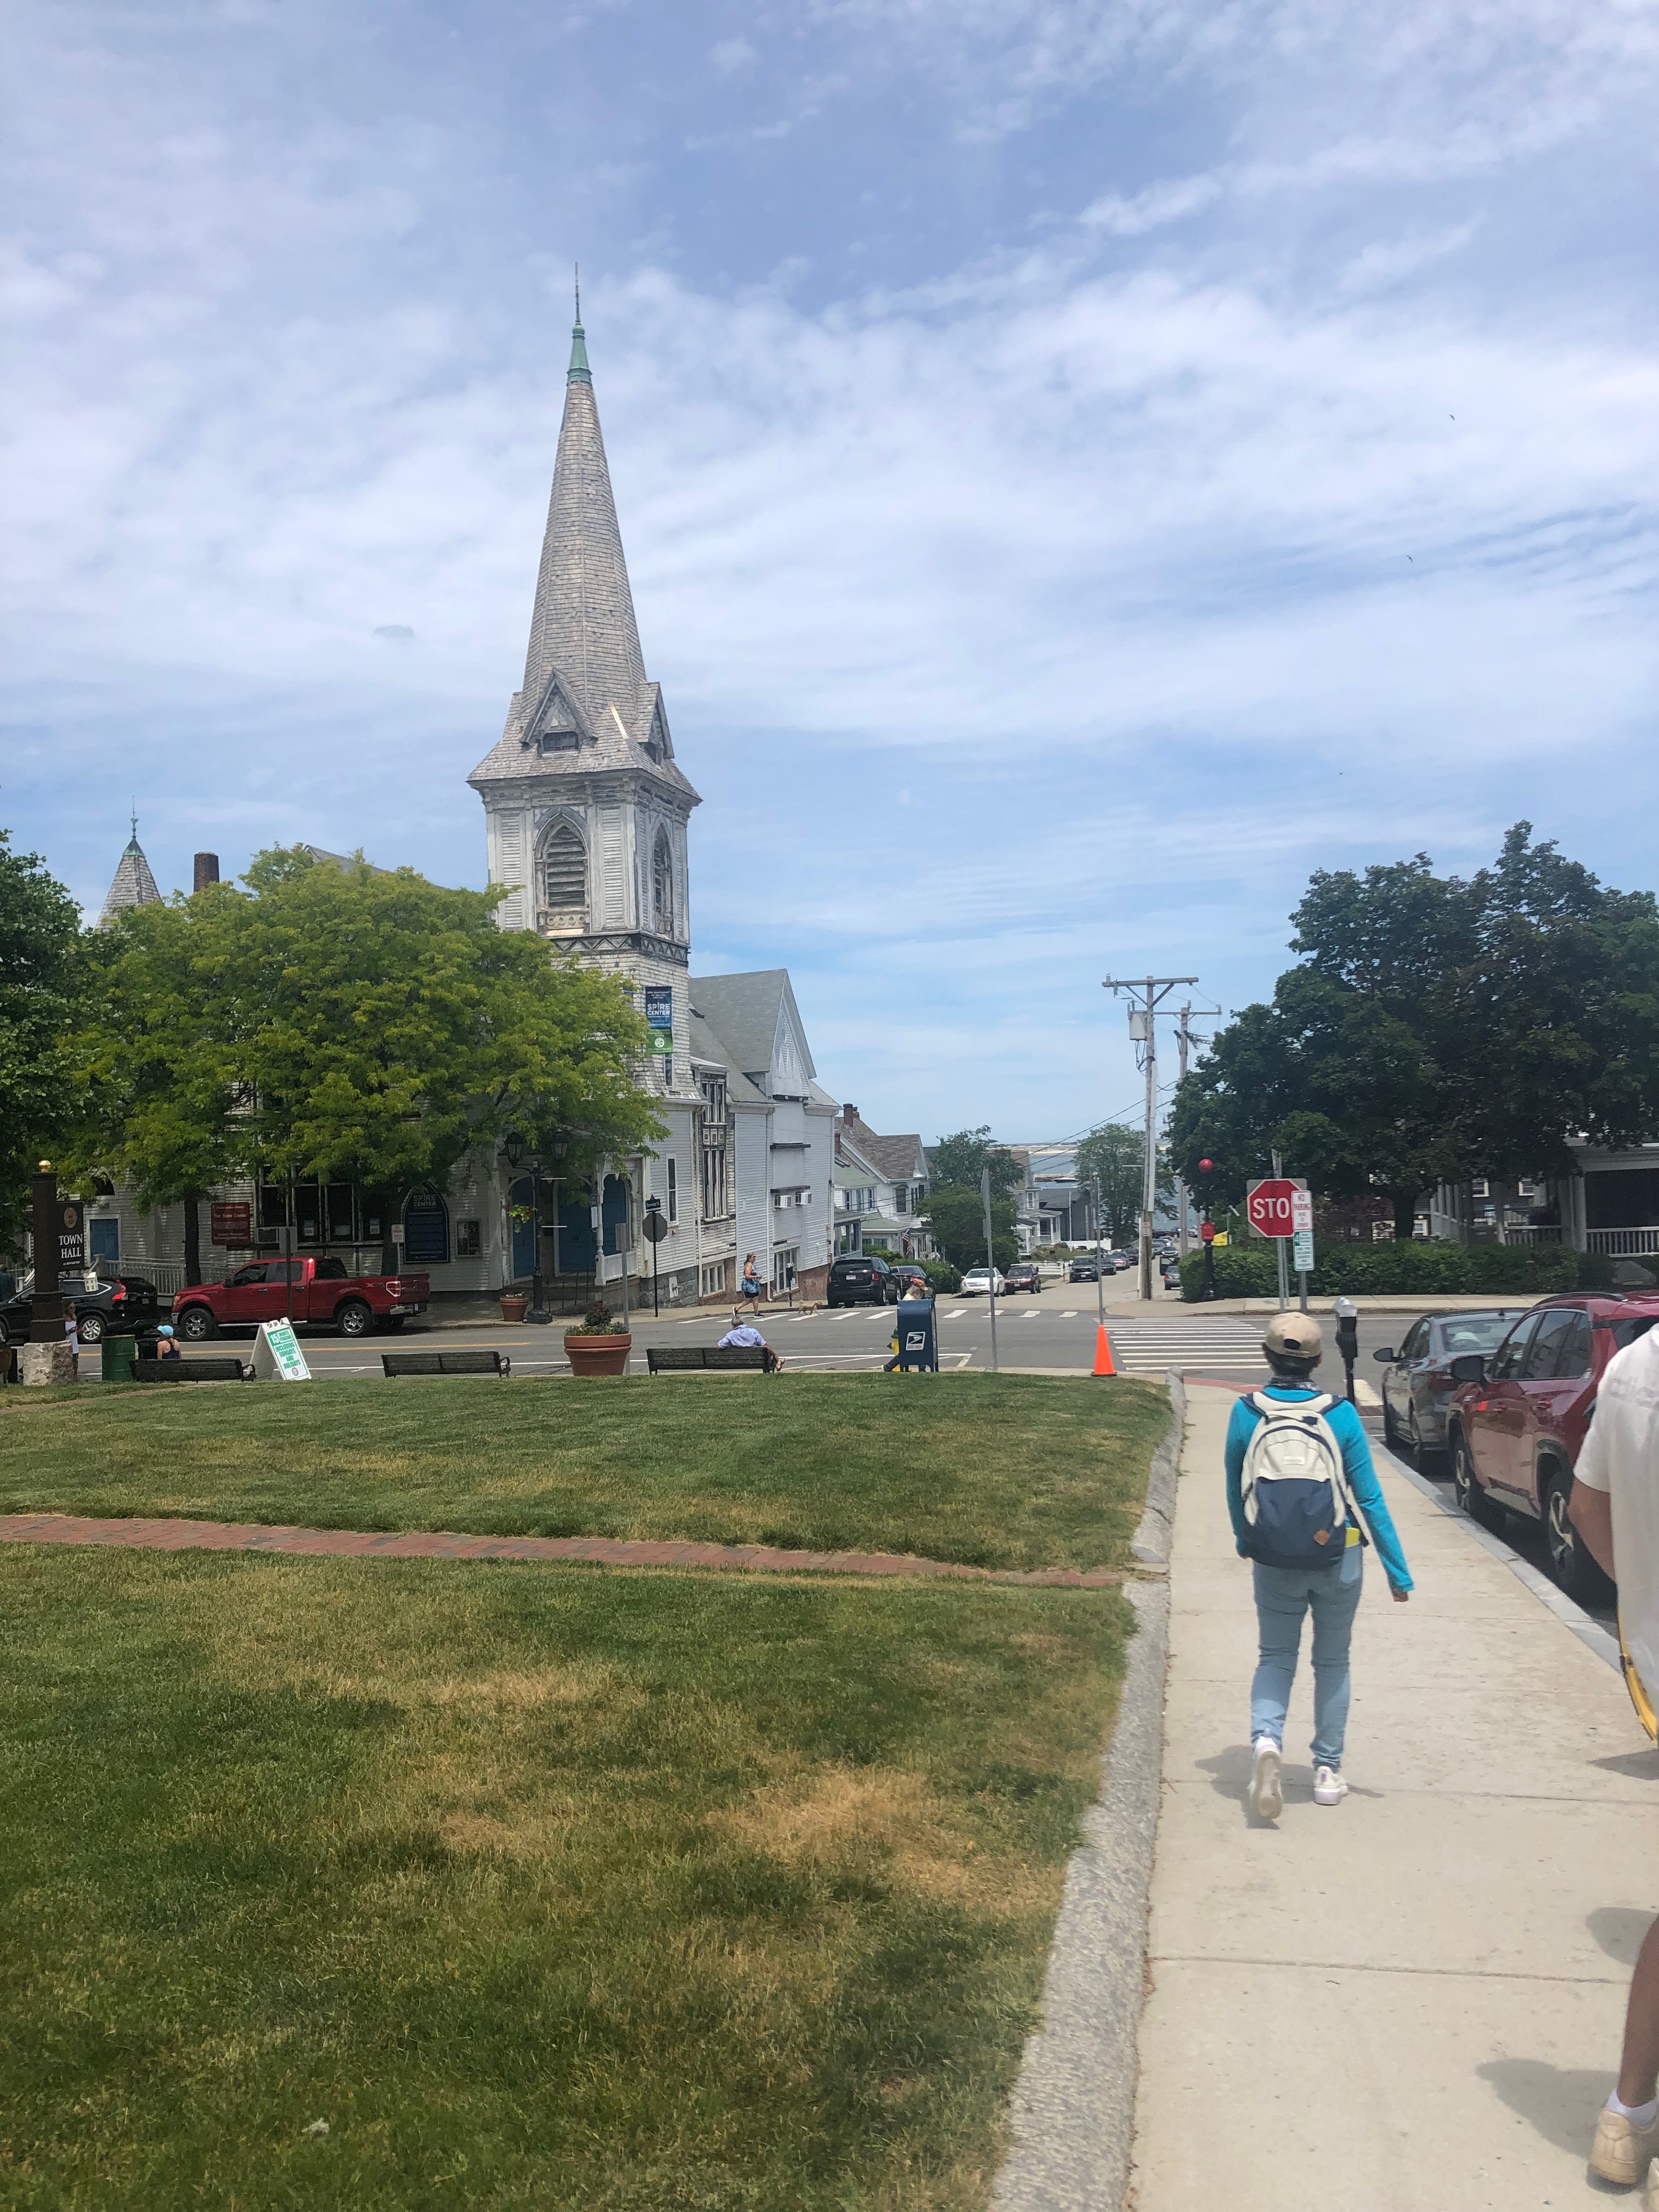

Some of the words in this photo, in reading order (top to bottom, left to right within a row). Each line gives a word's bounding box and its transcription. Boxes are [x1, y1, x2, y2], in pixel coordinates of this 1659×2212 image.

[647, 1002, 670, 1010] SPIRE
[413, 1193, 436, 1201] SPIRE
[1252, 1197, 1290, 1218] STO
[58, 1233, 83, 1246] TOWN
[61, 1247, 82, 1259] HALL
[270, 1334, 279, 1344] 15
